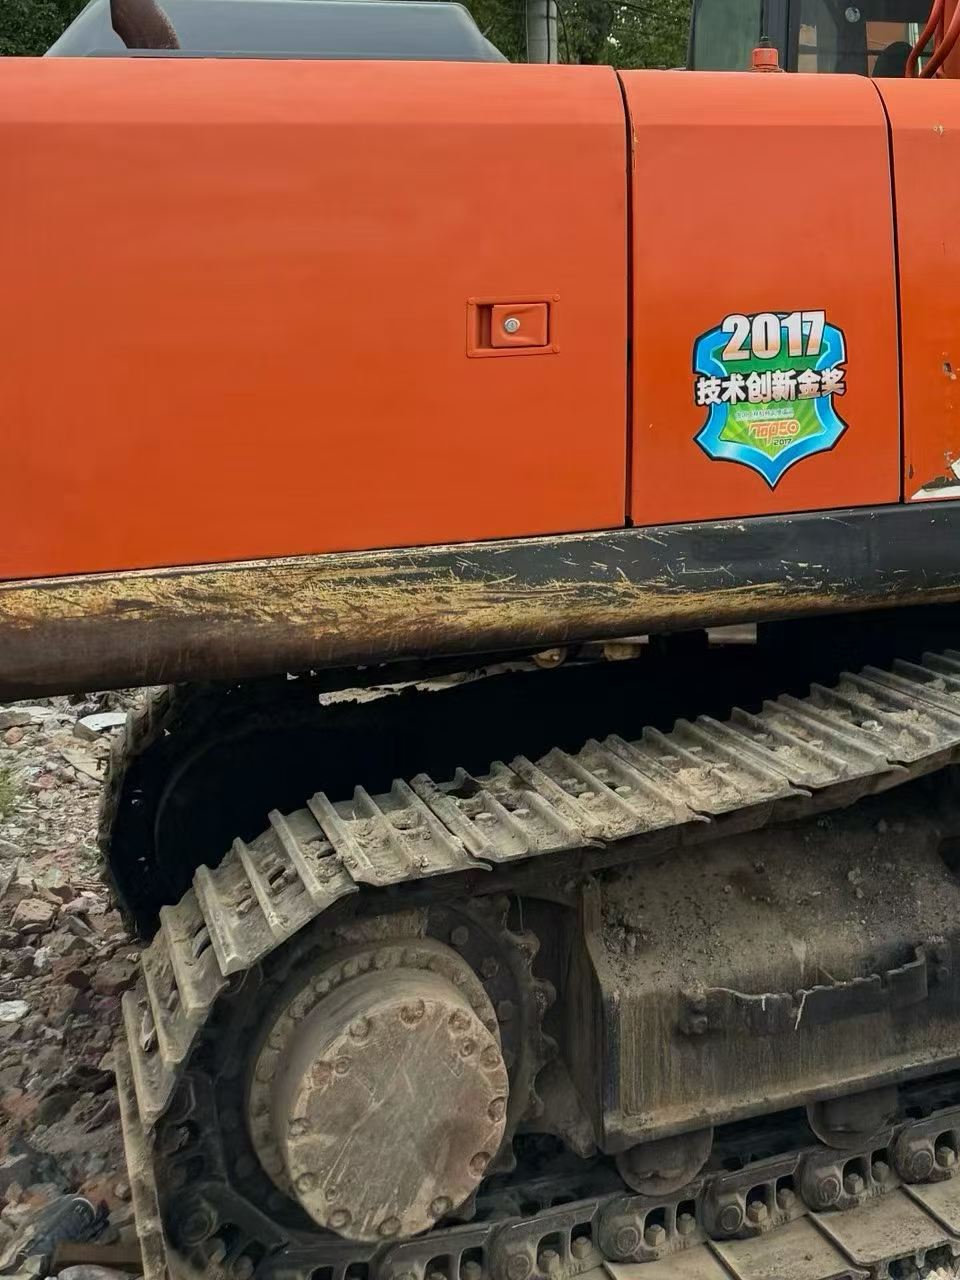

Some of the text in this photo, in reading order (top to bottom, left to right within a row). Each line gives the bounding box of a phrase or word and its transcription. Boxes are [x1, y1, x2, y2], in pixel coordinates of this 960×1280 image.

[722, 311, 826, 361] 2017
[697, 369, 845, 405] 技术创新金奖
[773, 438, 792, 446] 2017
